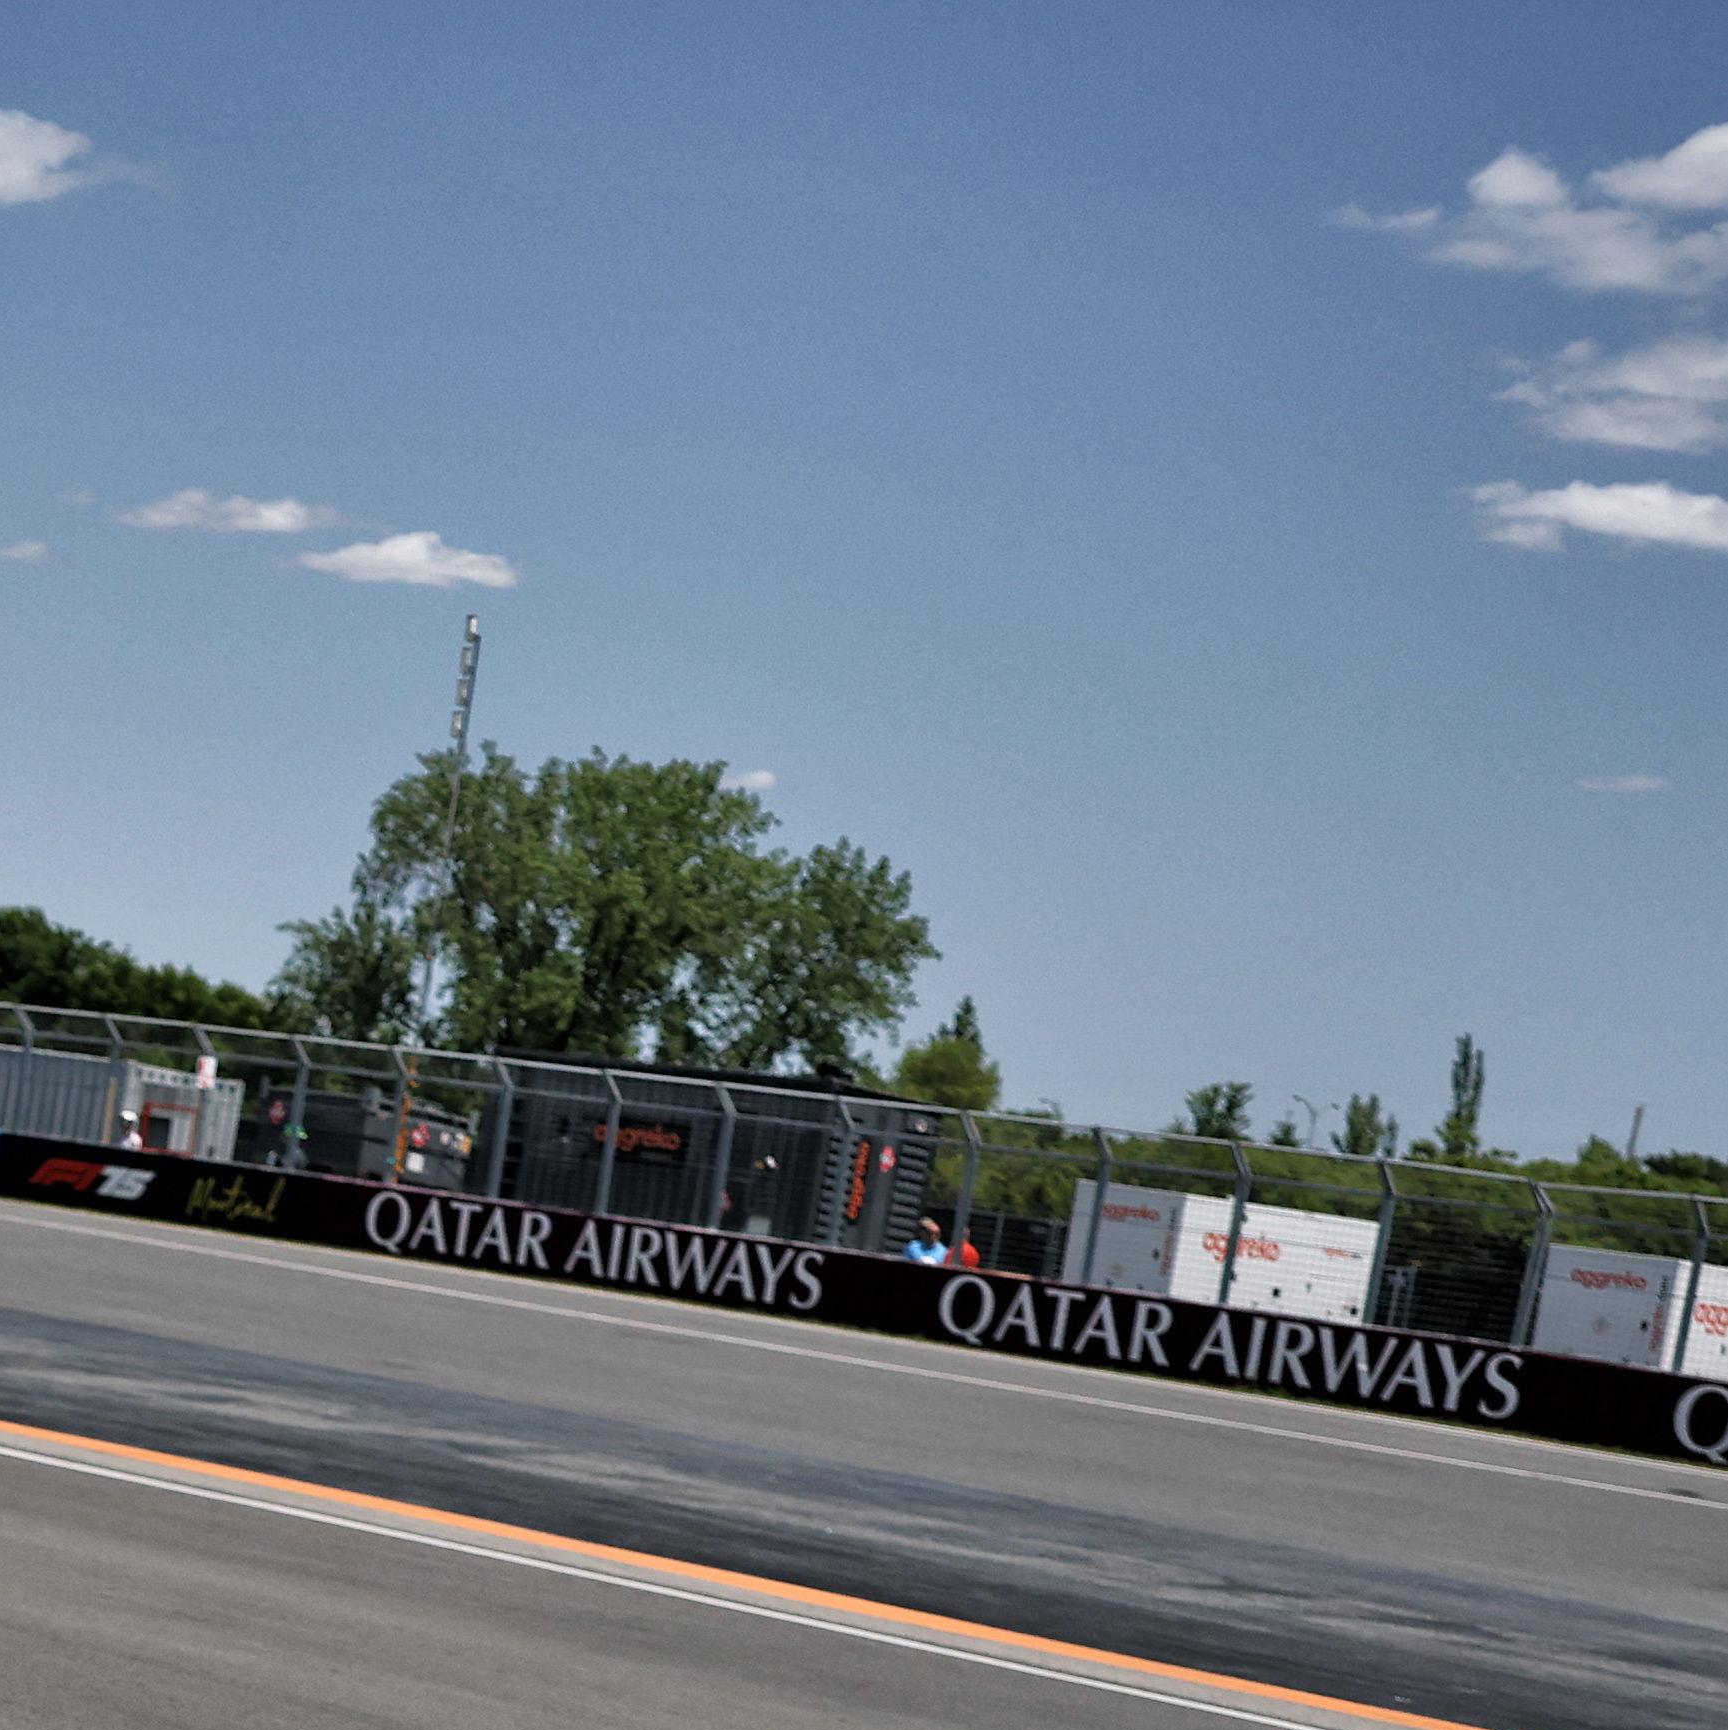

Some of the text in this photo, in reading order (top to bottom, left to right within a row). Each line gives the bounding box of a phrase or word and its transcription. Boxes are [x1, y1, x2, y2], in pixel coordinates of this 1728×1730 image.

[594, 1122, 682, 1151] agreko
[365, 1190, 826, 1312] QATAR AIRWAYS
[1202, 1229, 1281, 1263] agreko
[941, 1274, 1526, 1420] QATAR AIRWAYS
